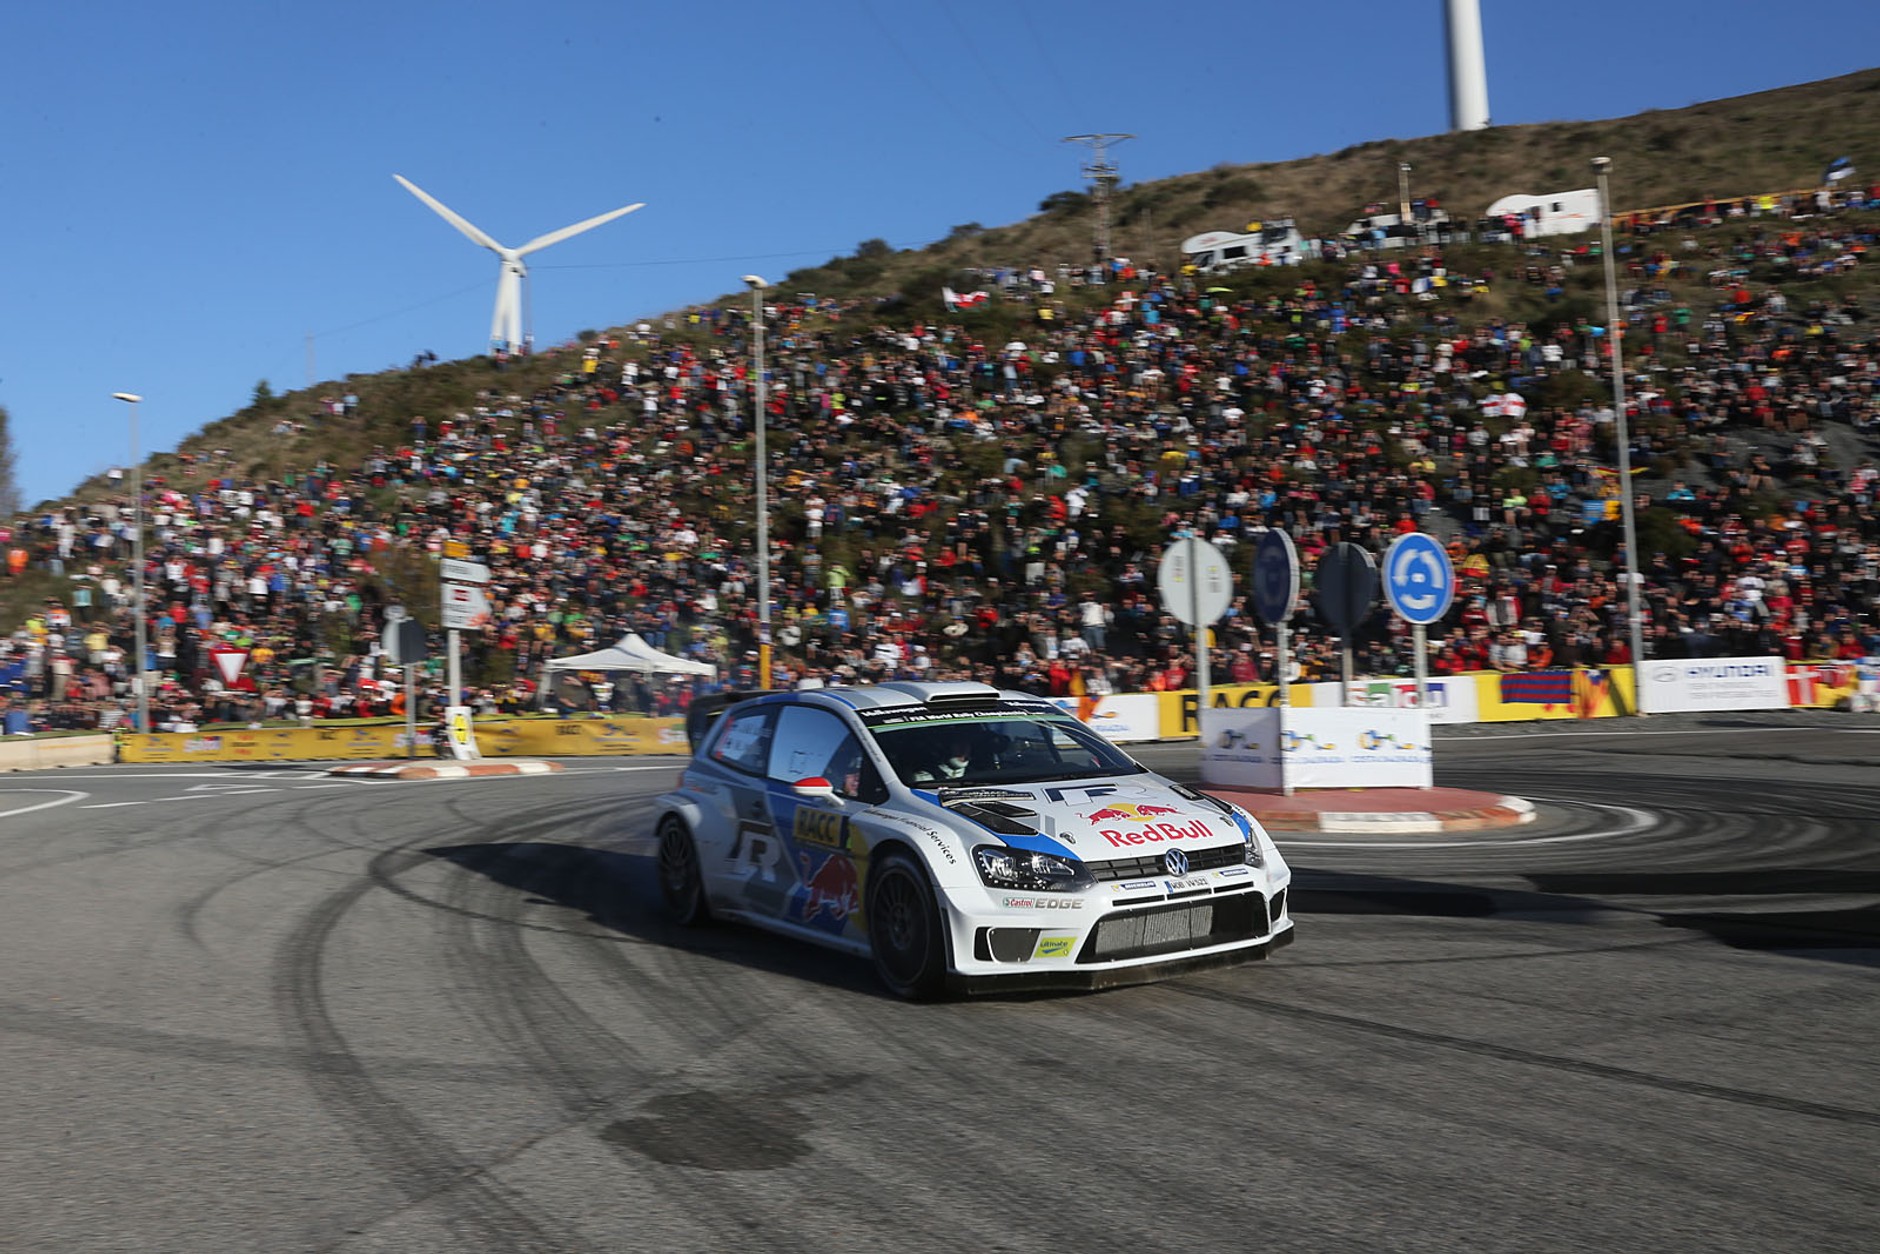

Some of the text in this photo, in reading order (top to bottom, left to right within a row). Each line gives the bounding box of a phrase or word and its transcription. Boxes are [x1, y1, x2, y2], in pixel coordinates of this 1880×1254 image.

[798, 809, 838, 842] RACC
[926, 831, 957, 865] Services
[1010, 898, 1085, 909] Castrol EDGE
[1040, 940, 1068, 948] ultimate
